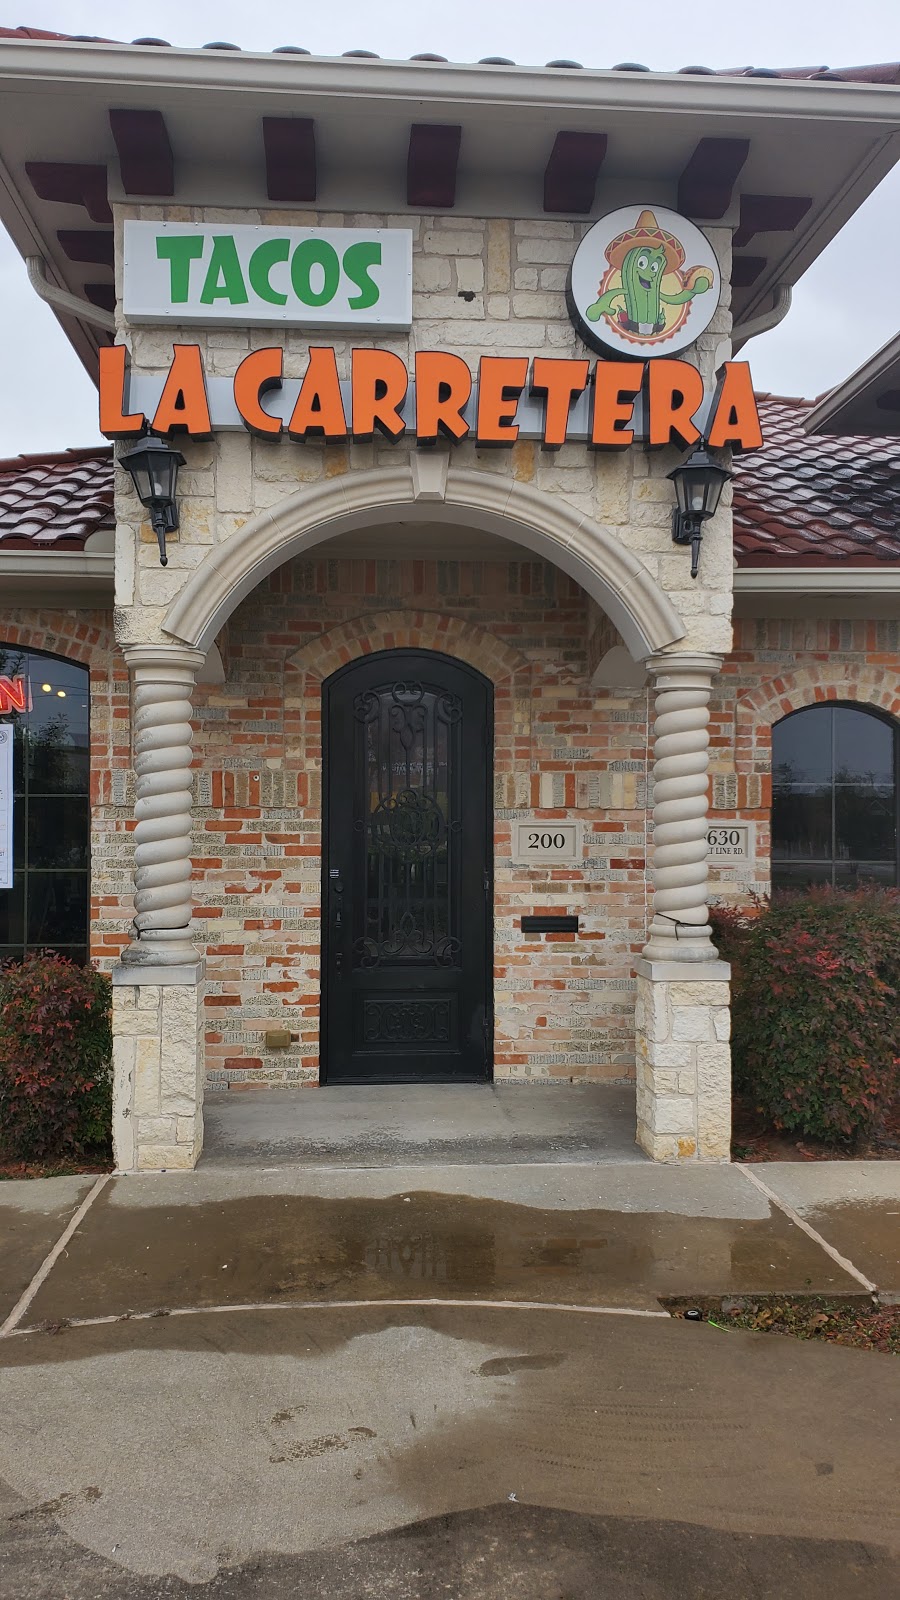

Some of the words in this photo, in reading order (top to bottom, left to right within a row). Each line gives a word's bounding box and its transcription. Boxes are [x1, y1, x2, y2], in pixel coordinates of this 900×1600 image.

[155, 235, 382, 310] TACOS
[99, 344, 214, 441] LA
[233, 346, 763, 451] CARRETERA
[528, 833, 566, 849] 200
[703, 830, 740, 846] 630
[715, 847, 732, 855] LINE
[733, 847, 744, 855] RD.
